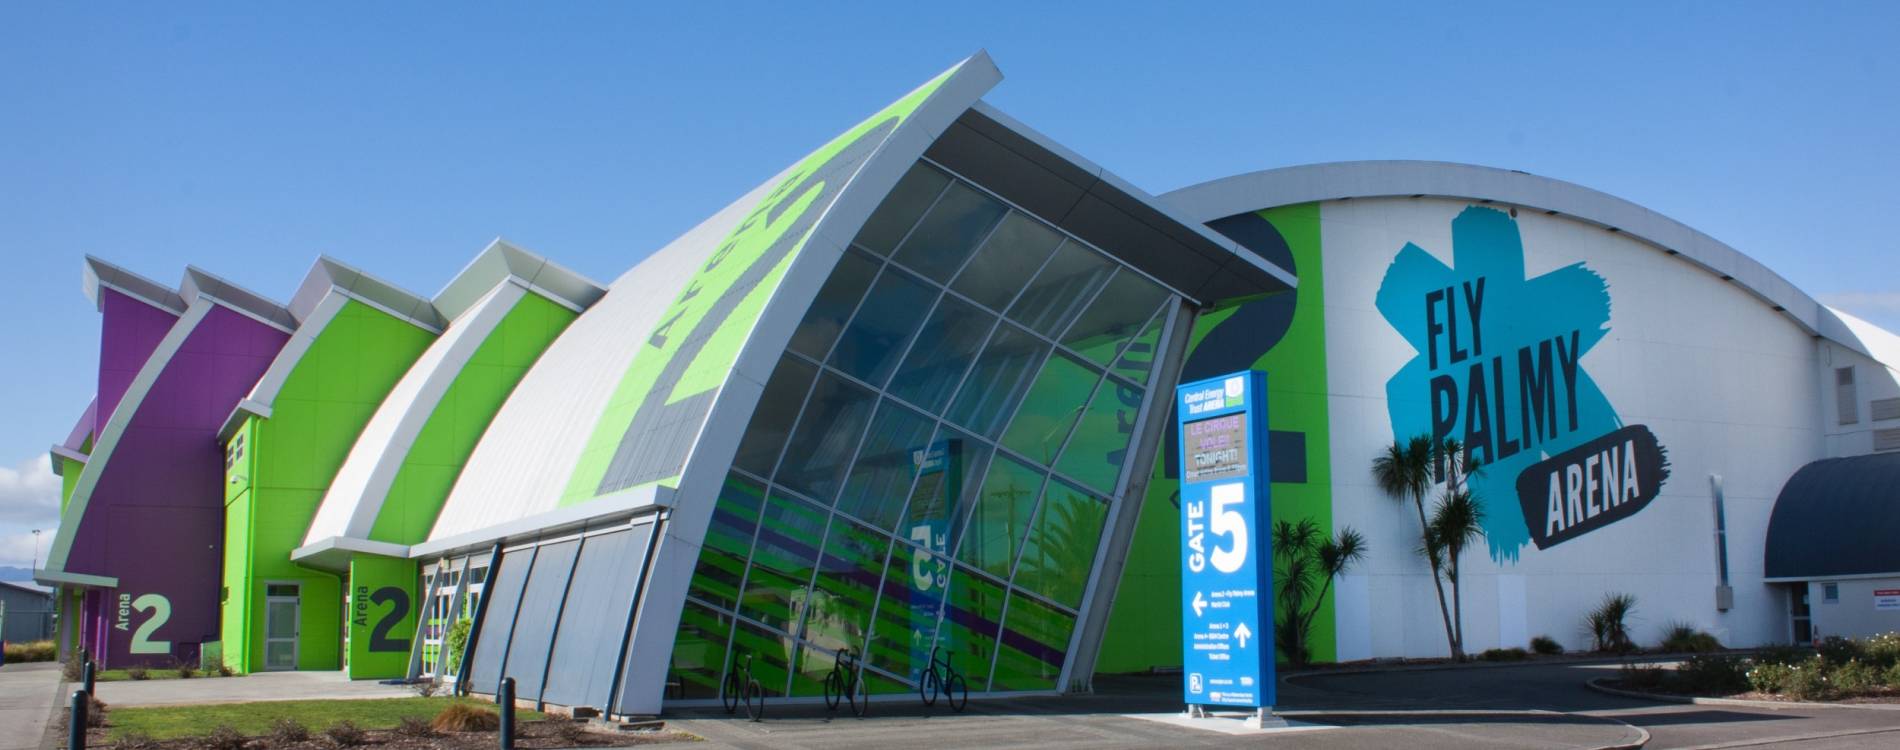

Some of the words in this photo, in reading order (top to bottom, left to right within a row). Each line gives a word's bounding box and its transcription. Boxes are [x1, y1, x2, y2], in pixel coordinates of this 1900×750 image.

[648, 170, 806, 349] Arena
[1425, 276, 1486, 371] FLY
[1429, 329, 1580, 485] PALMY
[1210, 482, 1248, 573] 5
[1545, 439, 1641, 538] ARENA
[1187, 500, 1205, 573] GATE
[115, 593, 131, 631] Arena
[129, 593, 172, 655] 2
[353, 585, 369, 627] Arena
[368, 586, 411, 653] 2
